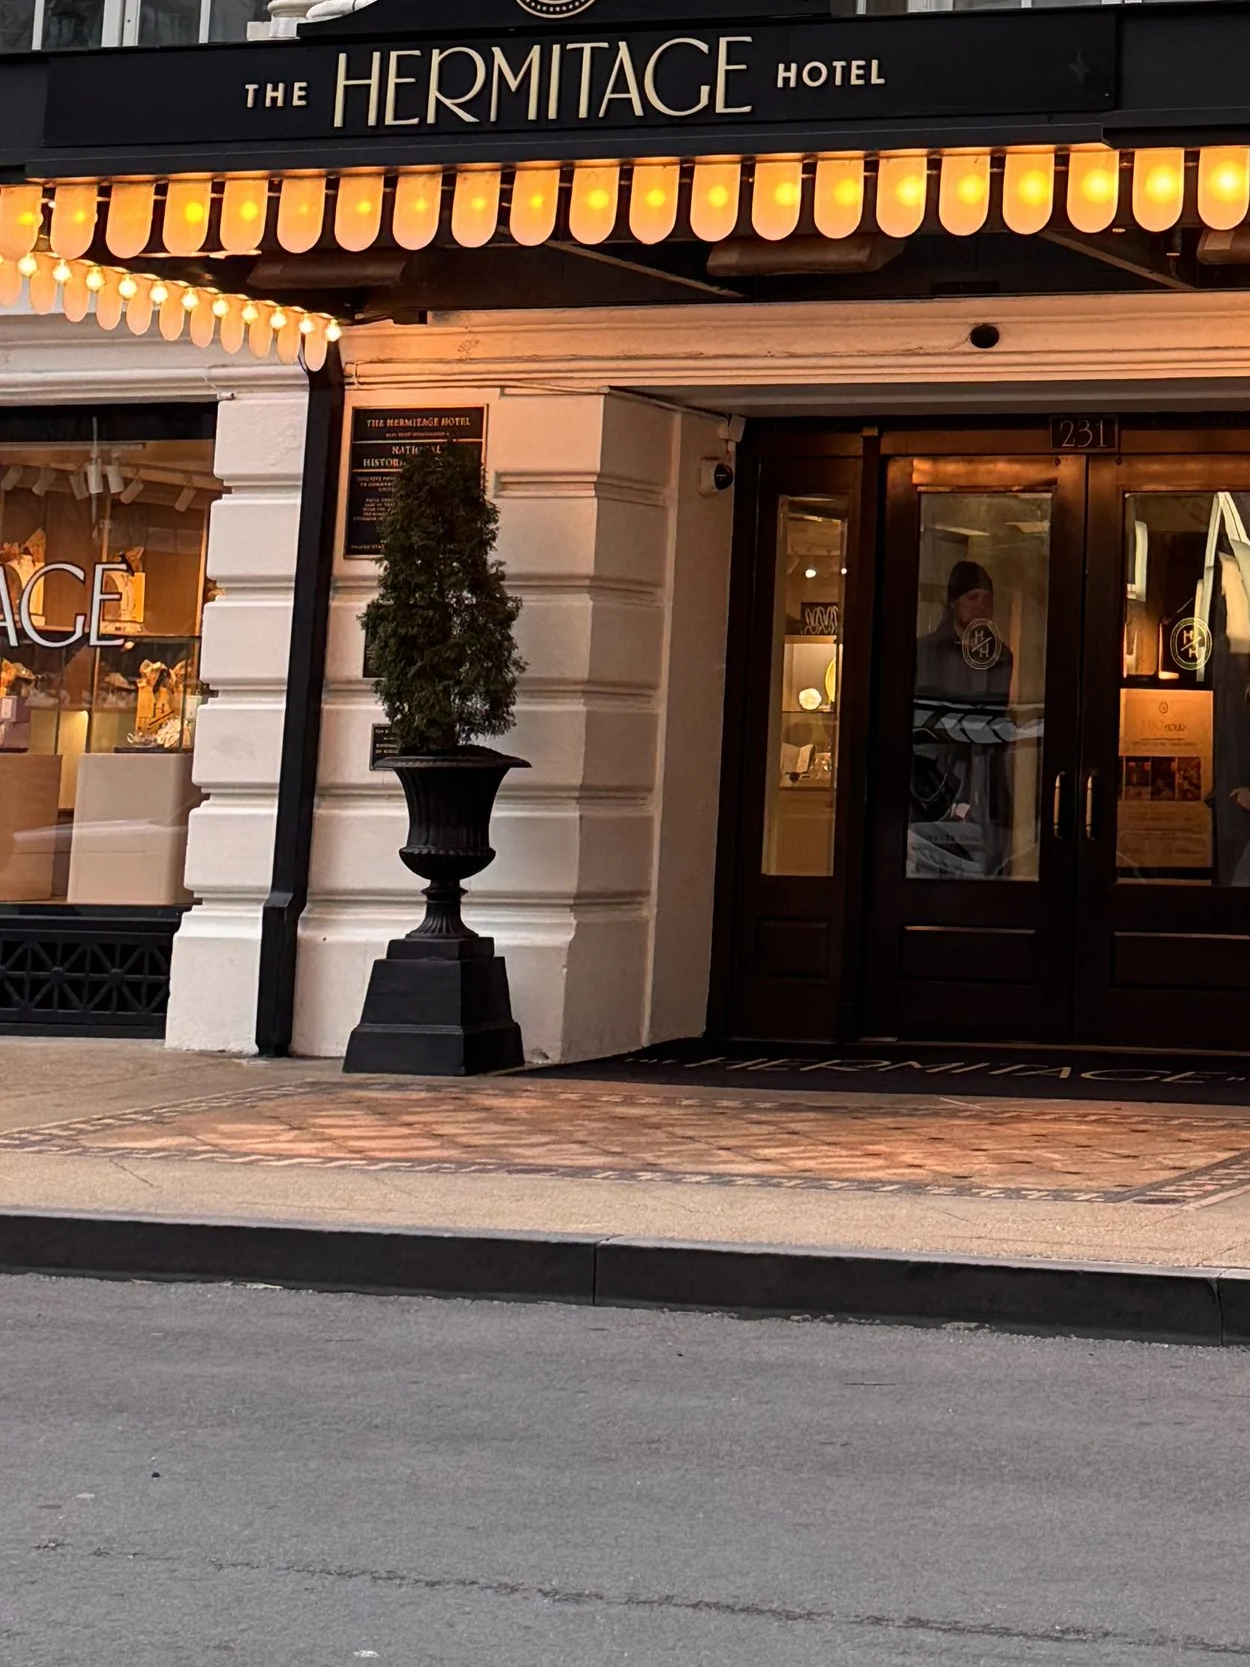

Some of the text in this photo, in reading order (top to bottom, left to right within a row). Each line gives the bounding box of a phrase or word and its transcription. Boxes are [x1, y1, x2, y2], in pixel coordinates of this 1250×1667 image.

[244, 36, 886, 129] THE HERMITAGE HOTEL
[367, 417, 471, 428] THE HERMITAGE HOTEL
[1059, 419, 1108, 448] 231
[684, 1056, 1229, 1084] HERMITAGE
